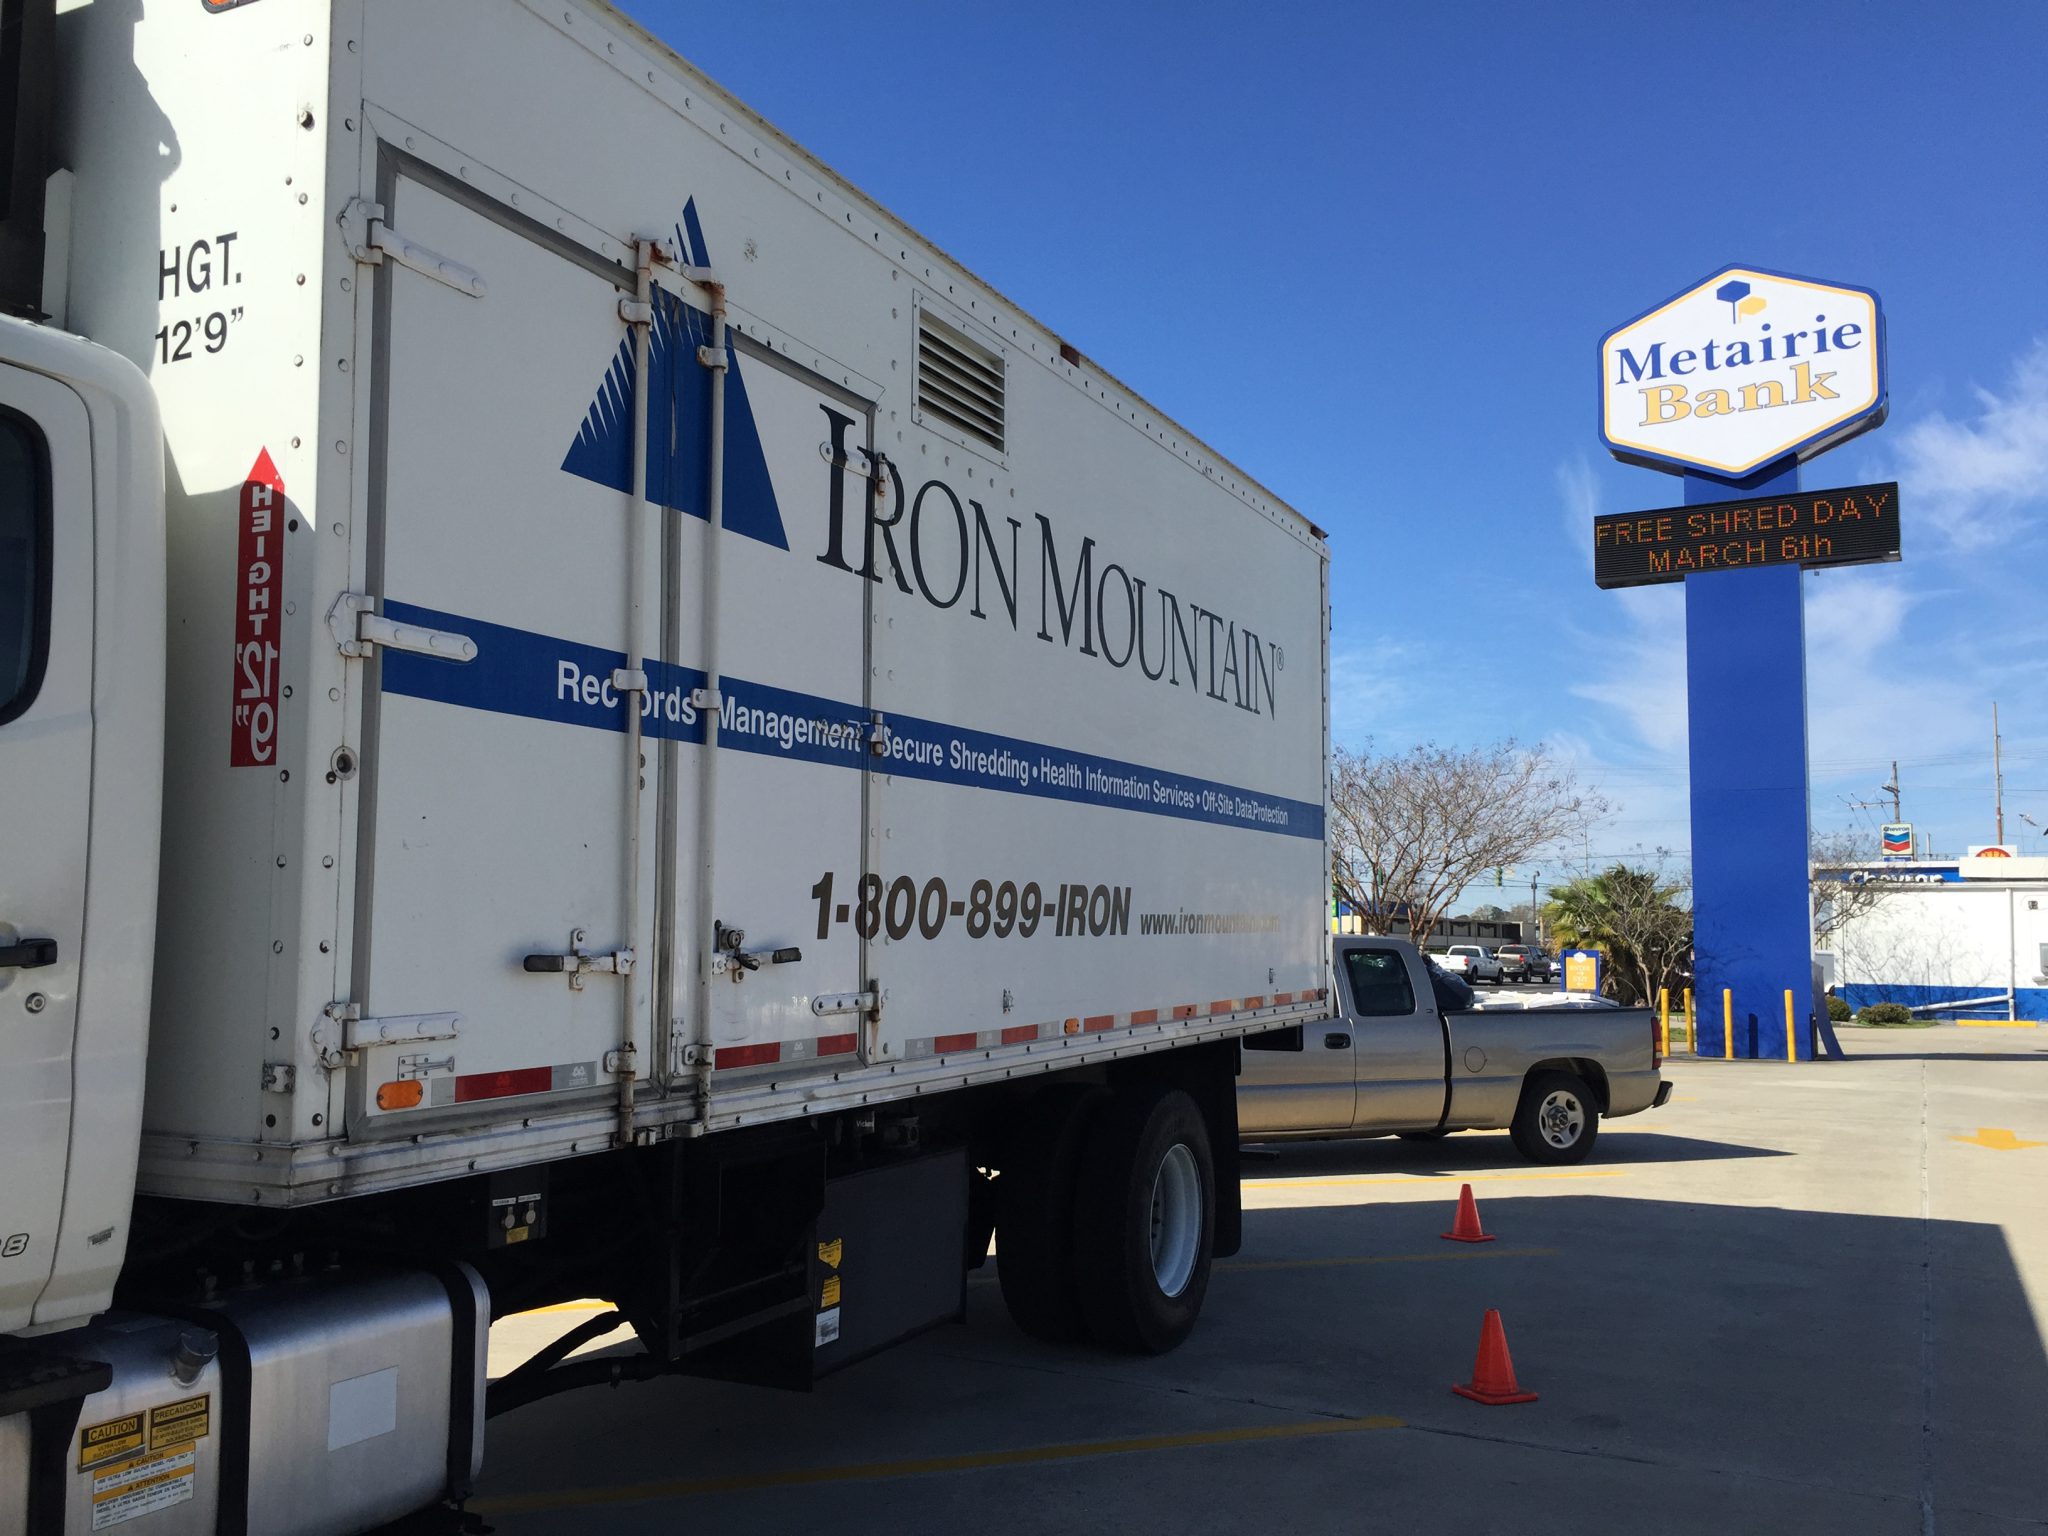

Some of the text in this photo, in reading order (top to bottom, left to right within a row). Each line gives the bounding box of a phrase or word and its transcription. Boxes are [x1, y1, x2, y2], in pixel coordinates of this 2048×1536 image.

[159, 231, 242, 301] HGT.
[1615, 314, 1862, 385] Metairie
[1638, 360, 1841, 427] Bank
[816, 402, 1022, 632] IRON
[1596, 493, 1888, 547] FREE SHRED DAY
[1649, 534, 1831, 573] MARCH 6th
[718, 694, 861, 753] Management
[883, 725, 944, 767] Secure
[949, 739, 1029, 787] Shredding
[1040, 763, 1082, 790] Health
[1085, 766, 1151, 802] Information
[1153, 782, 1194, 809] Services
[1202, 789, 1233, 816] Off-Site
[811, 871, 1132, 941] 1-800-899-IRON
[0, 1233, 30, 1257] 8
[90, 1420, 135, 1441] CAUTION
